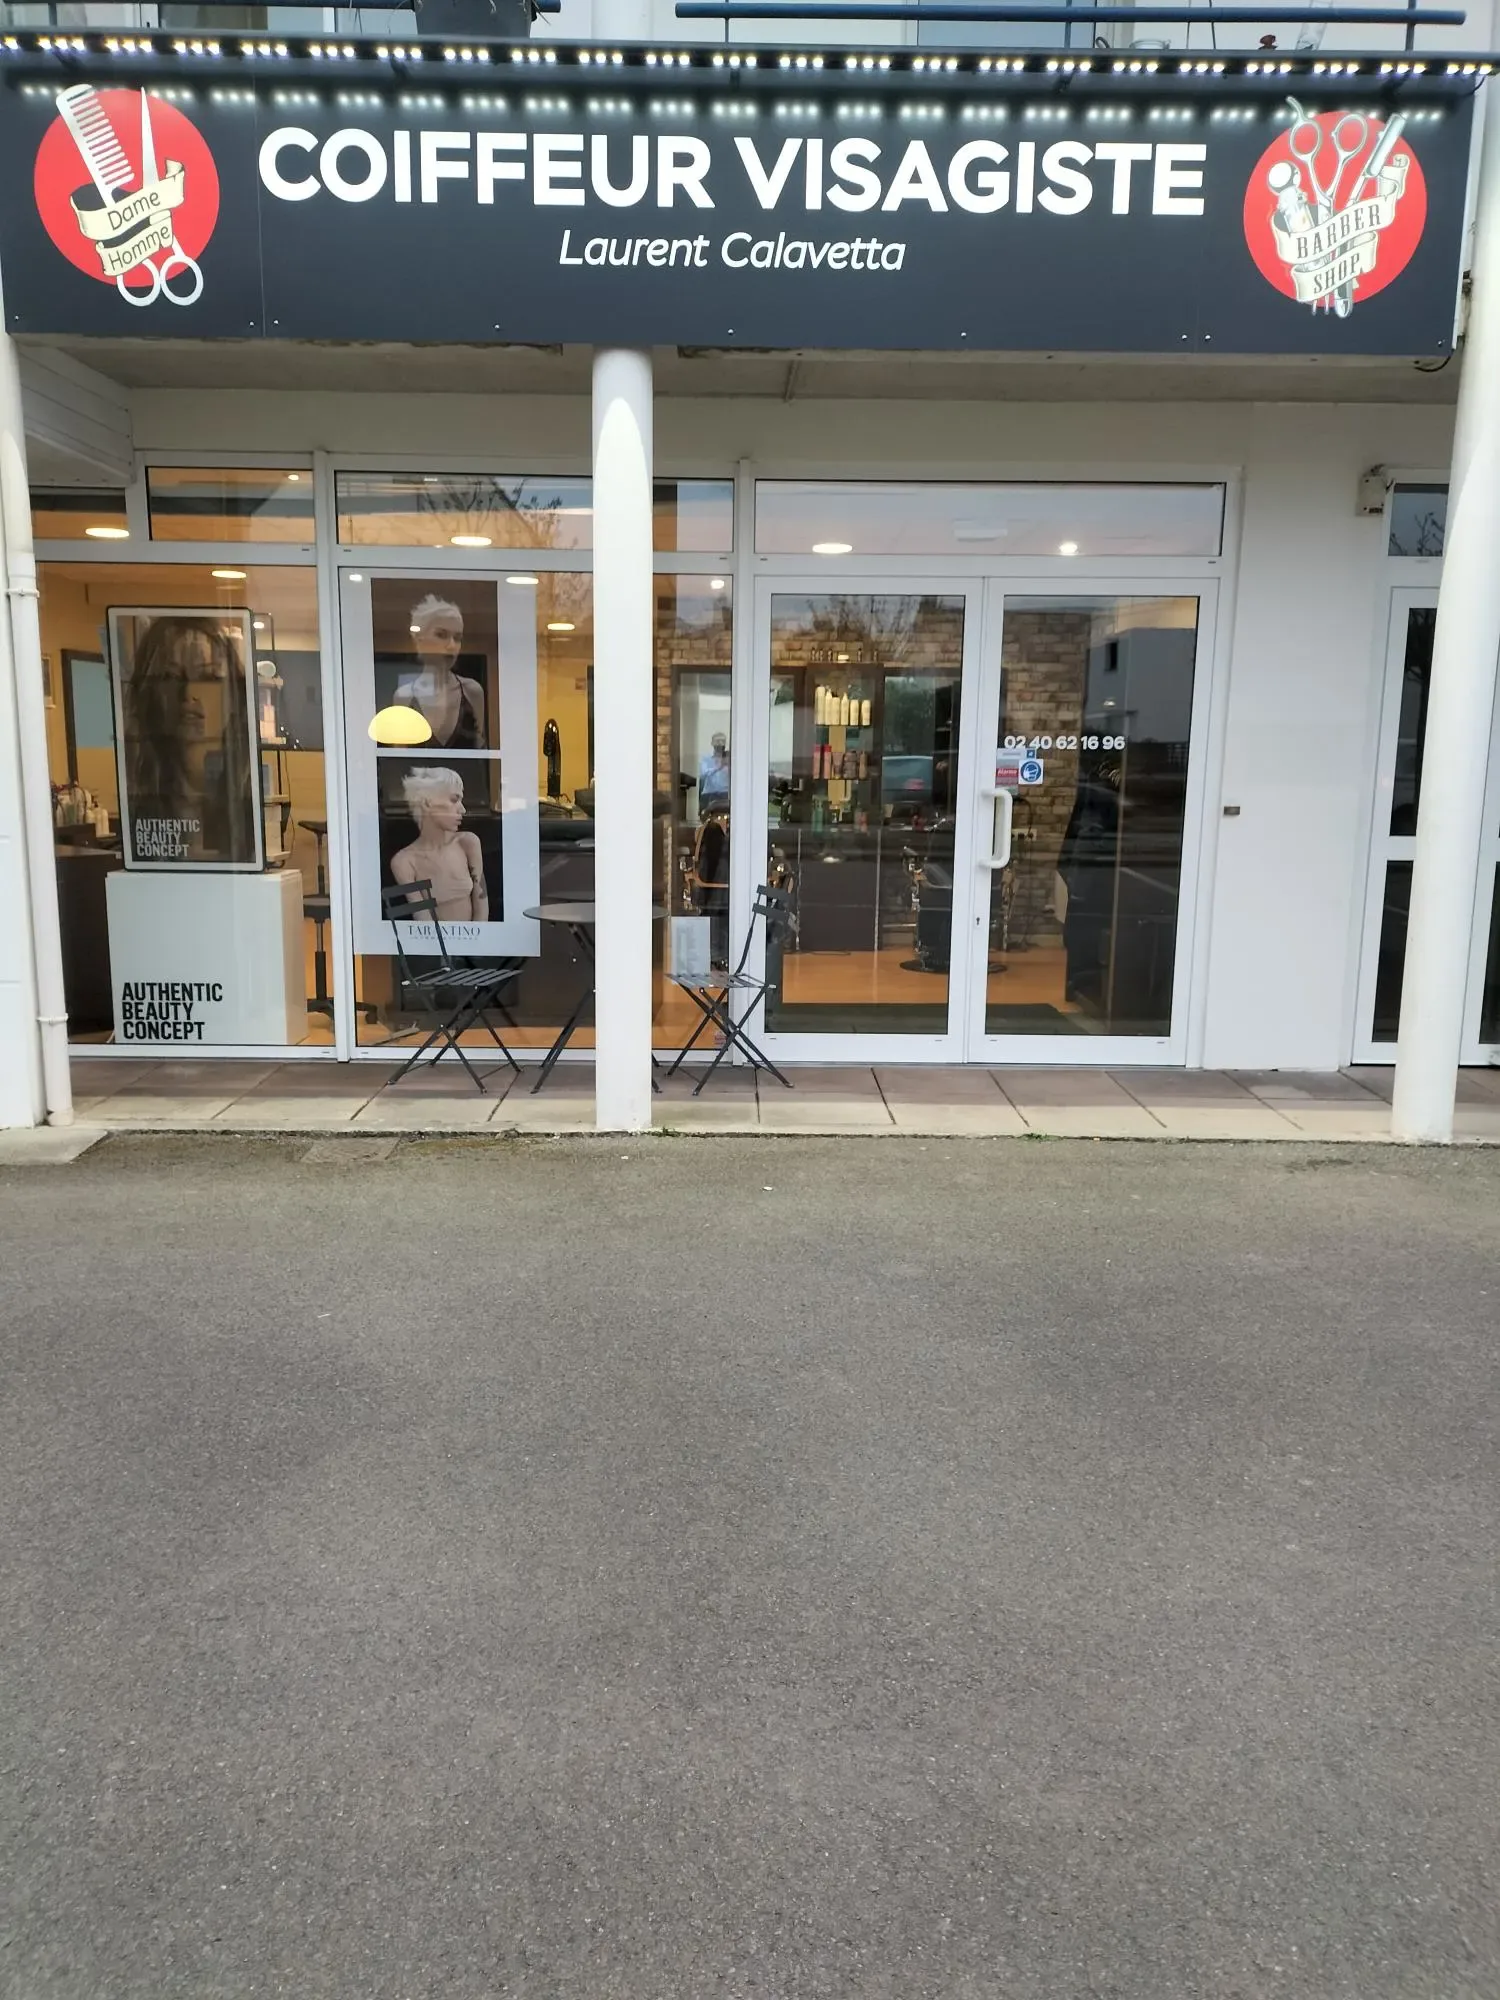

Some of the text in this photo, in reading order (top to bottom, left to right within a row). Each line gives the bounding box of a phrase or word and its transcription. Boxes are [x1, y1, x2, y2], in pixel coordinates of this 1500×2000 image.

[258, 126, 1208, 217] COIFFEUR VISAGISTE
[107, 192, 161, 231] Dame
[1296, 203, 1381, 259] BARBER
[108, 226, 170, 271] Homme
[559, 229, 906, 271] Laurent Calavetta
[1313, 252, 1361, 294] SHOP
[1004, 735, 1126, 750] 02 40 62 16 96
[135, 818, 201, 832] AUTHENTIC
[135, 831, 181, 844] BEAUTY
[136, 843, 190, 857] CONCEPT
[408, 925, 481, 936] TARNTINO
[122, 982, 223, 1002] AUTHENTIC
[122, 1001, 194, 1021] BEAUTY
[123, 1020, 205, 1040] CONCEPT
